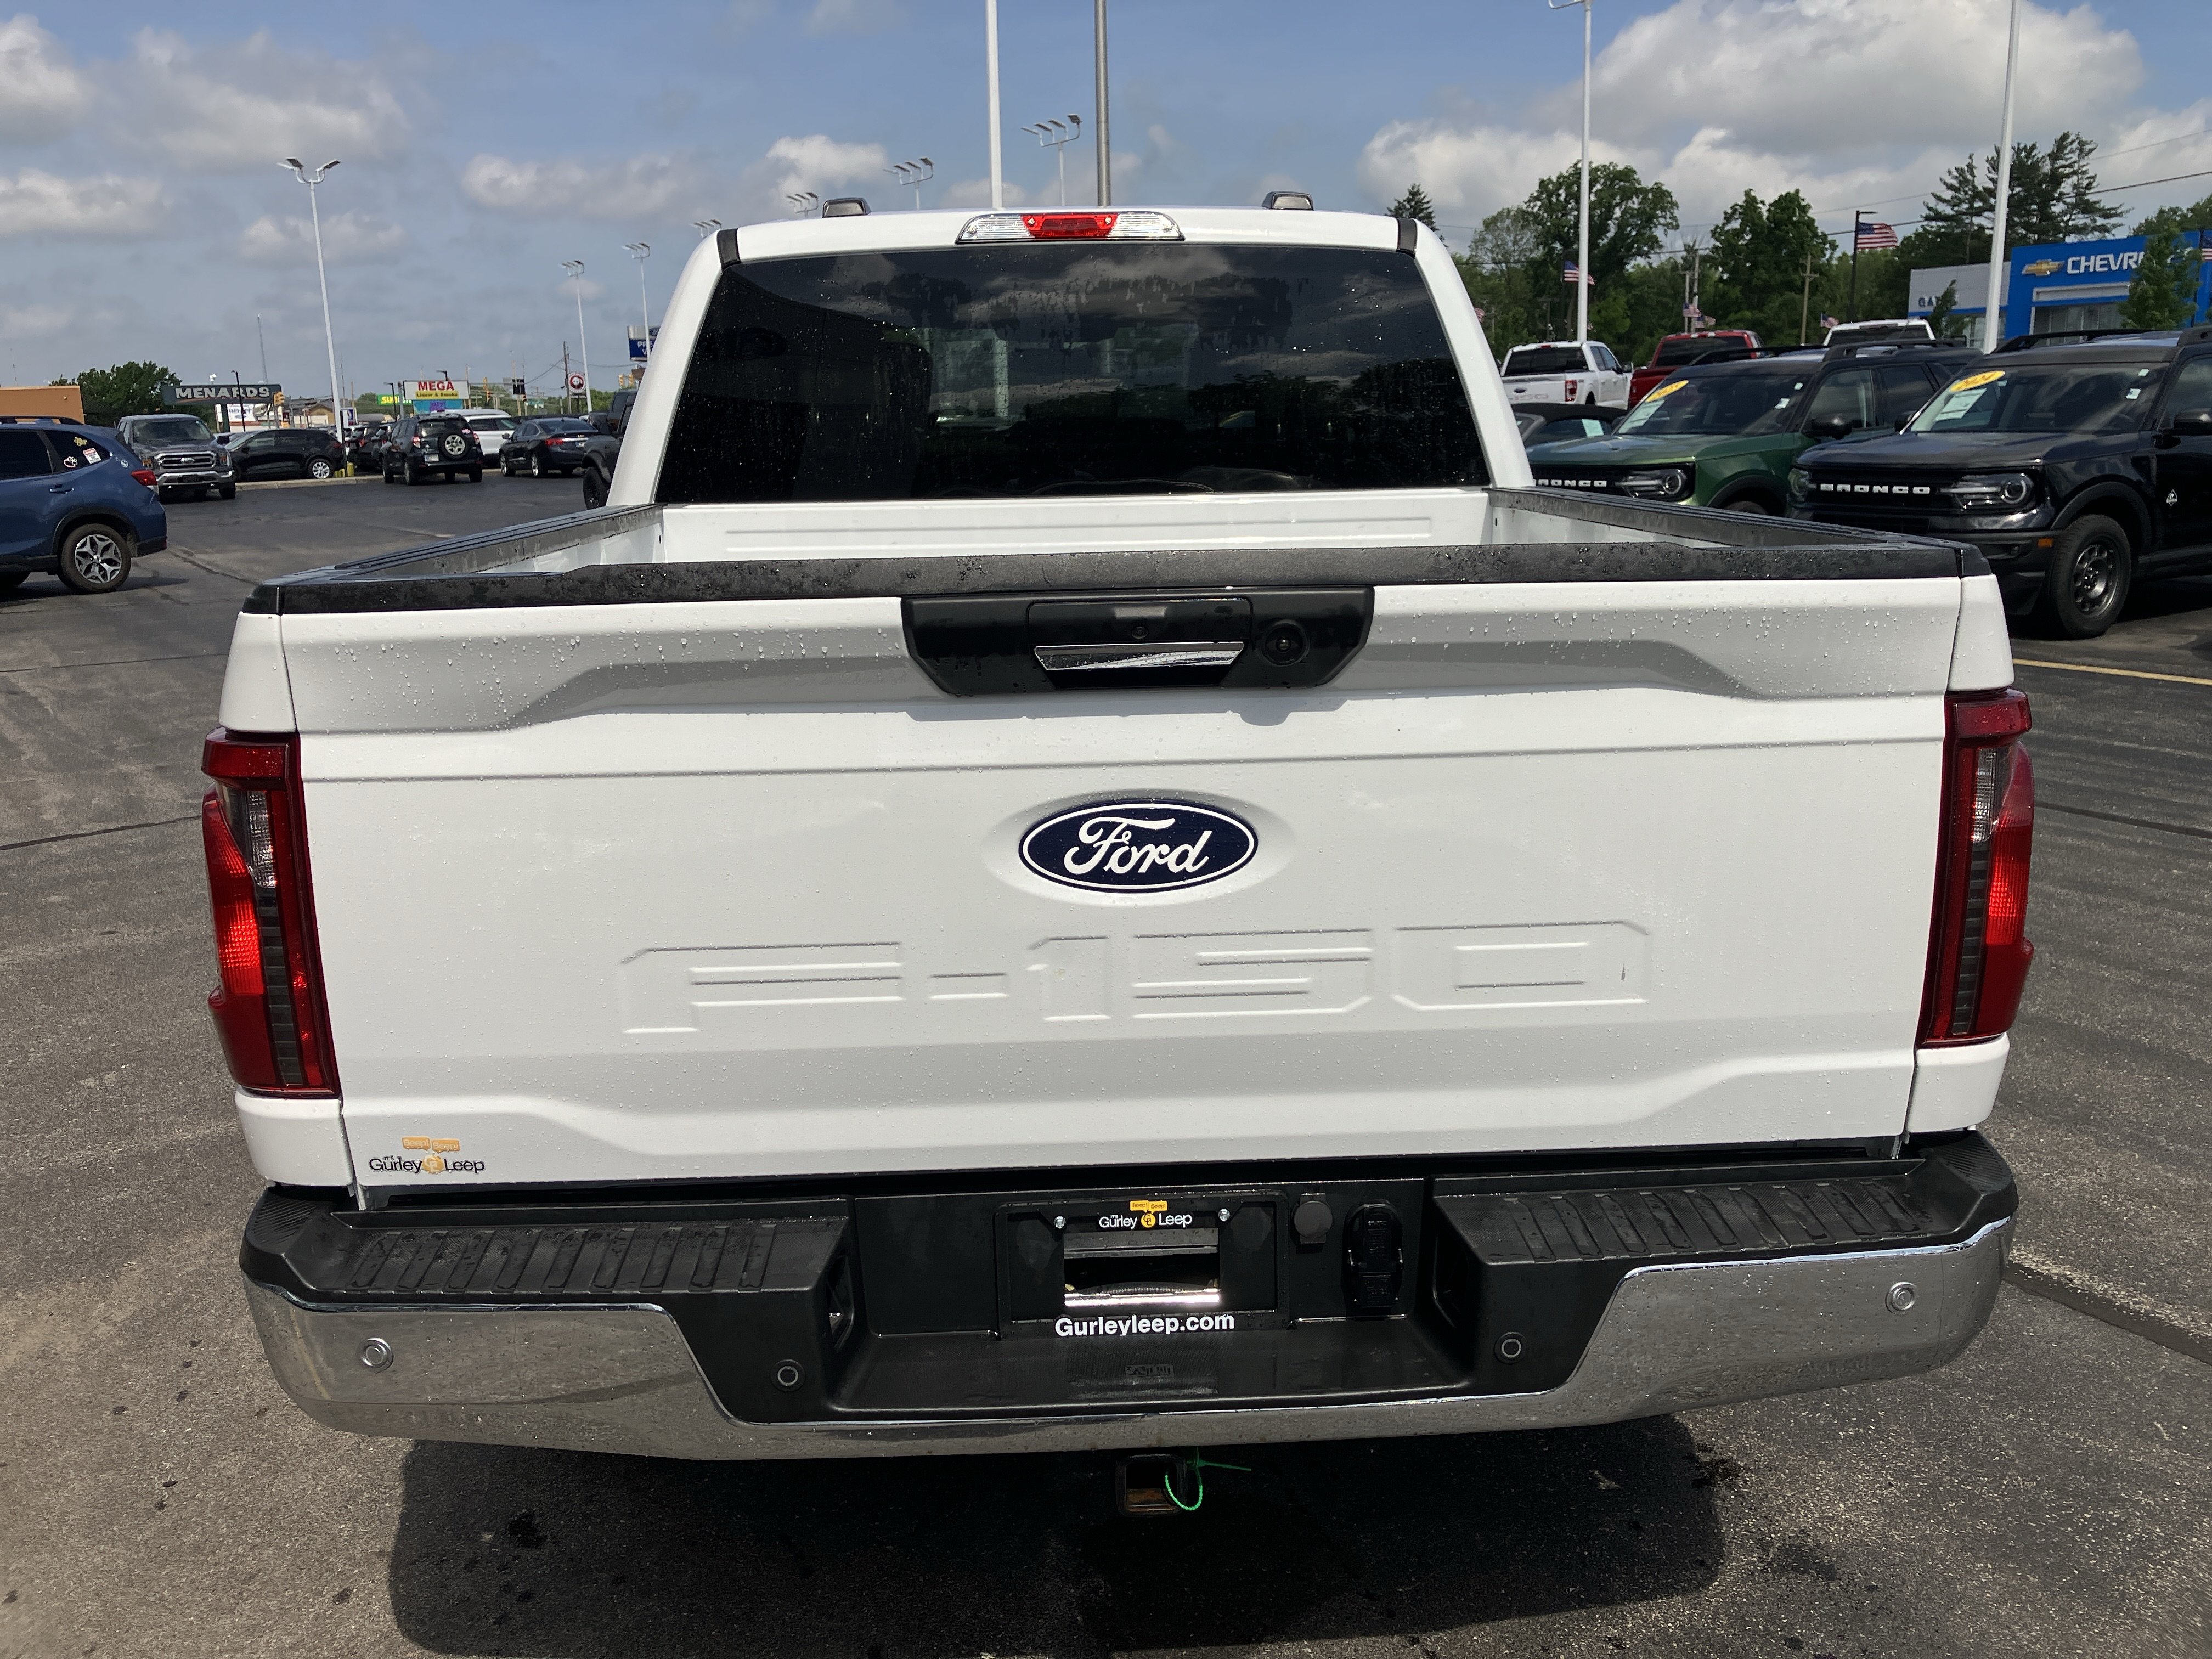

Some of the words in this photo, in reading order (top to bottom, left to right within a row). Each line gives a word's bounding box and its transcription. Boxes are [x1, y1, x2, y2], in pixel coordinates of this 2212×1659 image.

[175, 387, 270, 399] MENARDS
[418, 381, 454, 391] MEGA
[1533, 479, 1607, 488] RONCO
[1820, 483, 1931, 494] BRONCO
[1064, 816, 1213, 875] Ford
[620, 920, 1649, 1036] F-150
[444, 1159, 485, 1173] Leep
[1159, 1213, 1192, 1228] Leep
[1054, 1314, 1235, 1336] Gurleyleep.com
